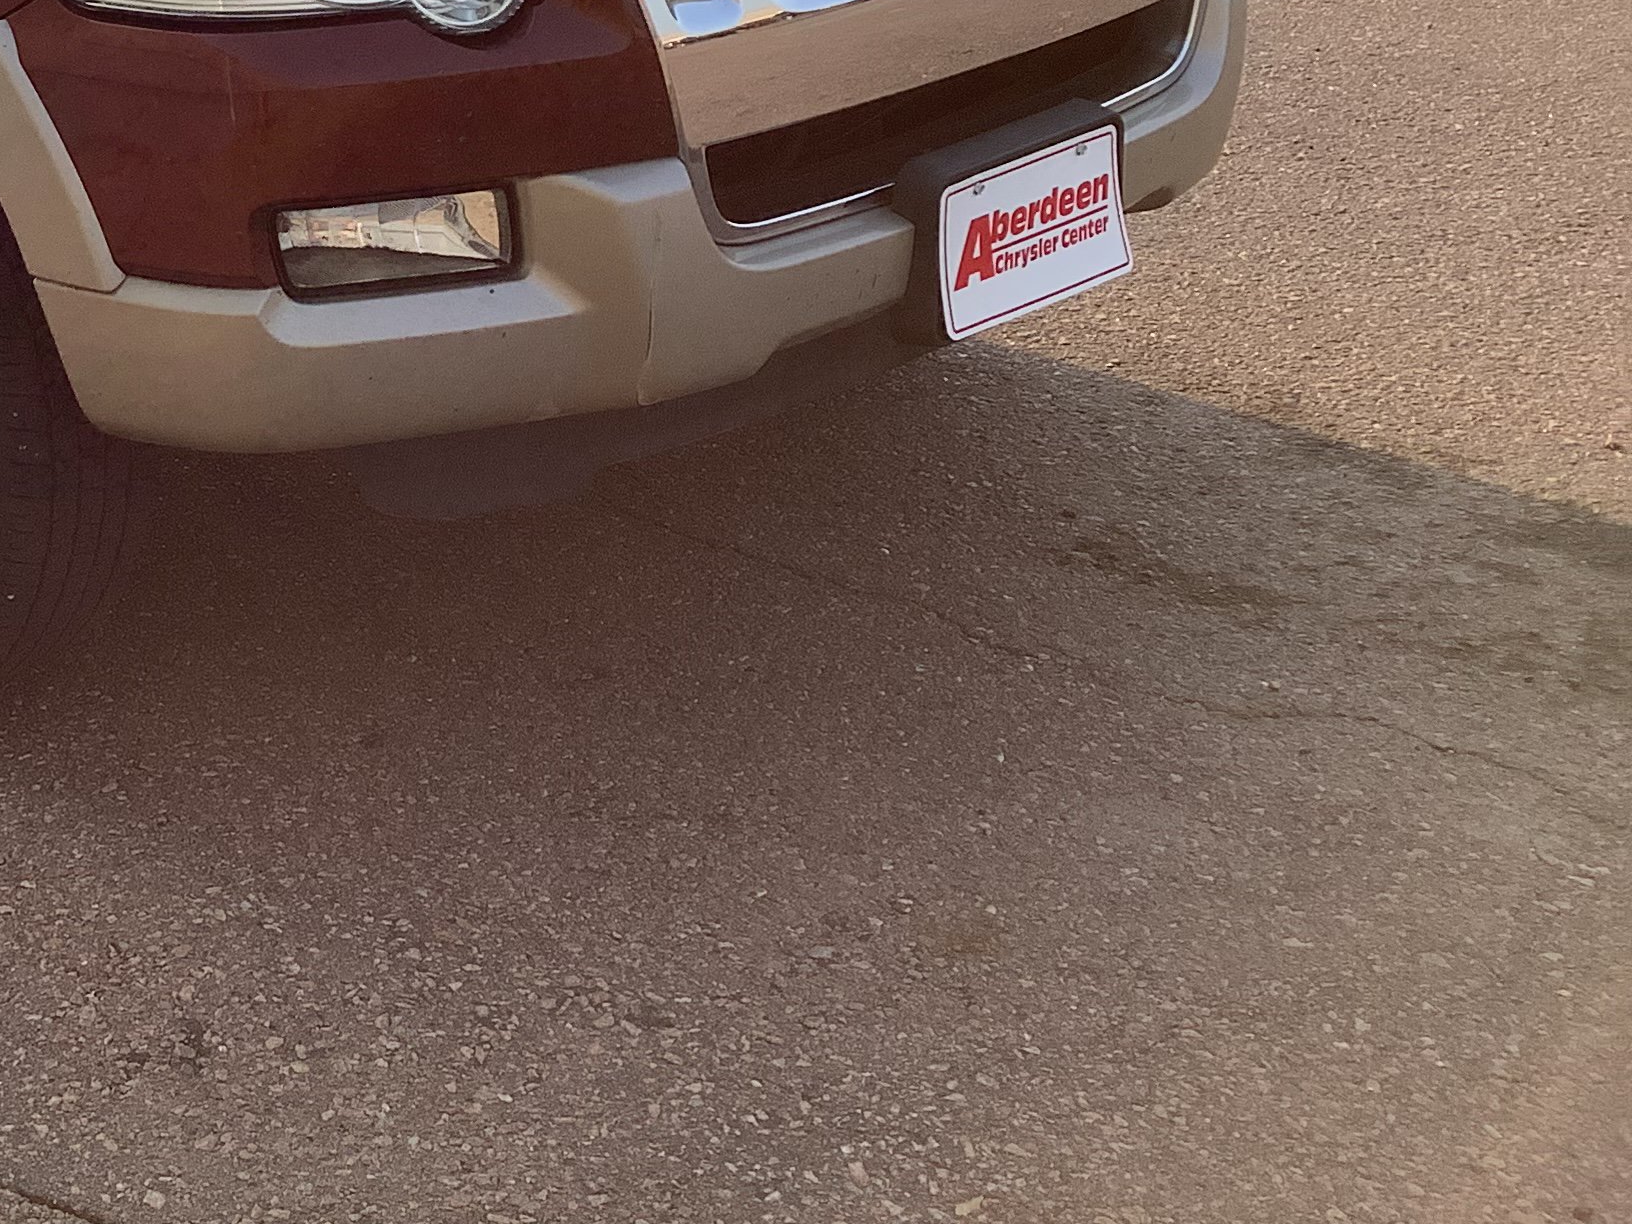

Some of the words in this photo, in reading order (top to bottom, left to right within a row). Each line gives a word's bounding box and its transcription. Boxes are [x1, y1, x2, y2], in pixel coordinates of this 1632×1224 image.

[953, 173, 1109, 292] Aberdeen
[994, 234, 1060, 275] Chrysler
[1061, 215, 1109, 249] Center
